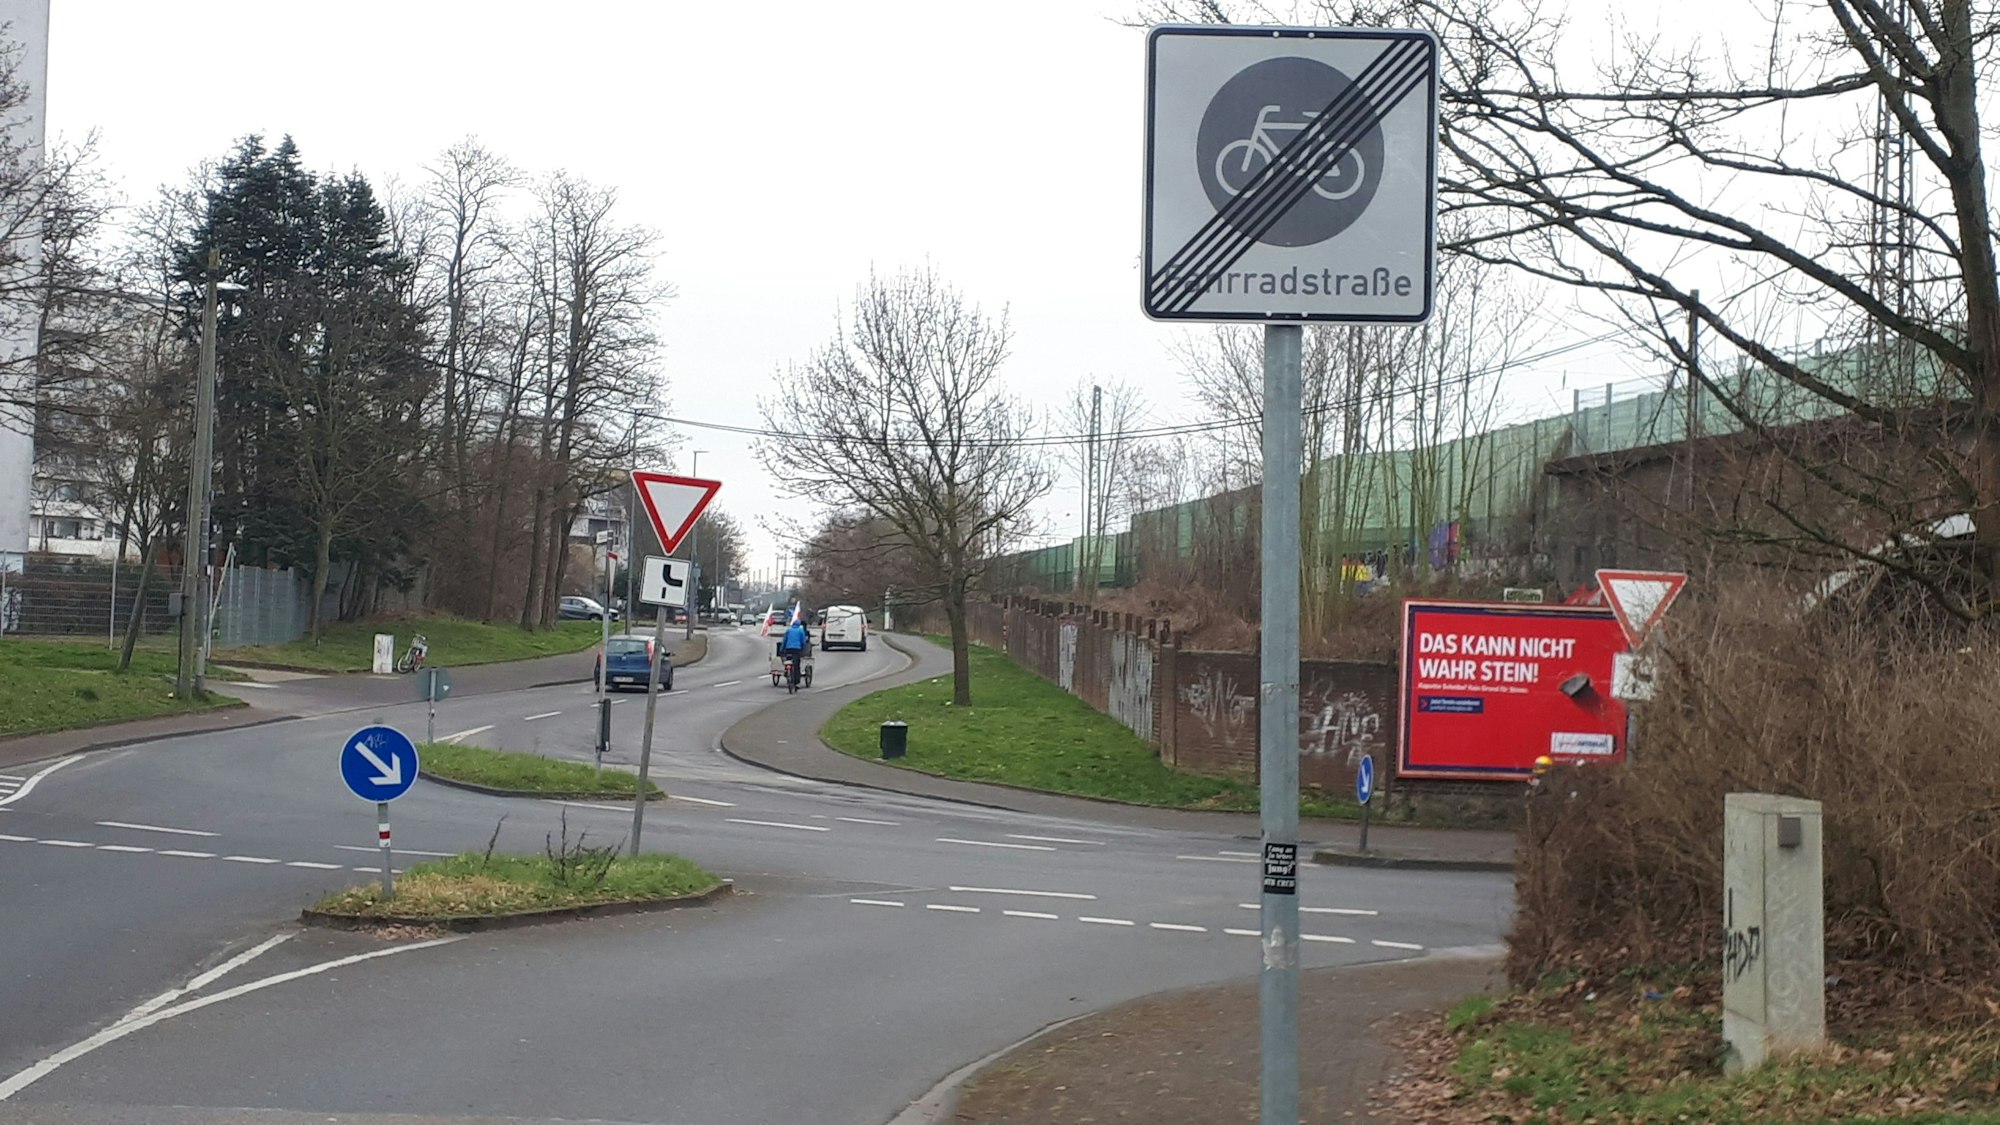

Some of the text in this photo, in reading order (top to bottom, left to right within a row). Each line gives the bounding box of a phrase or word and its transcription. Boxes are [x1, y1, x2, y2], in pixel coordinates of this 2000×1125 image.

[1419, 633, 1576, 659] DAS KANN NICHT
[1418, 658, 1539, 683] WAHR STEIN!
